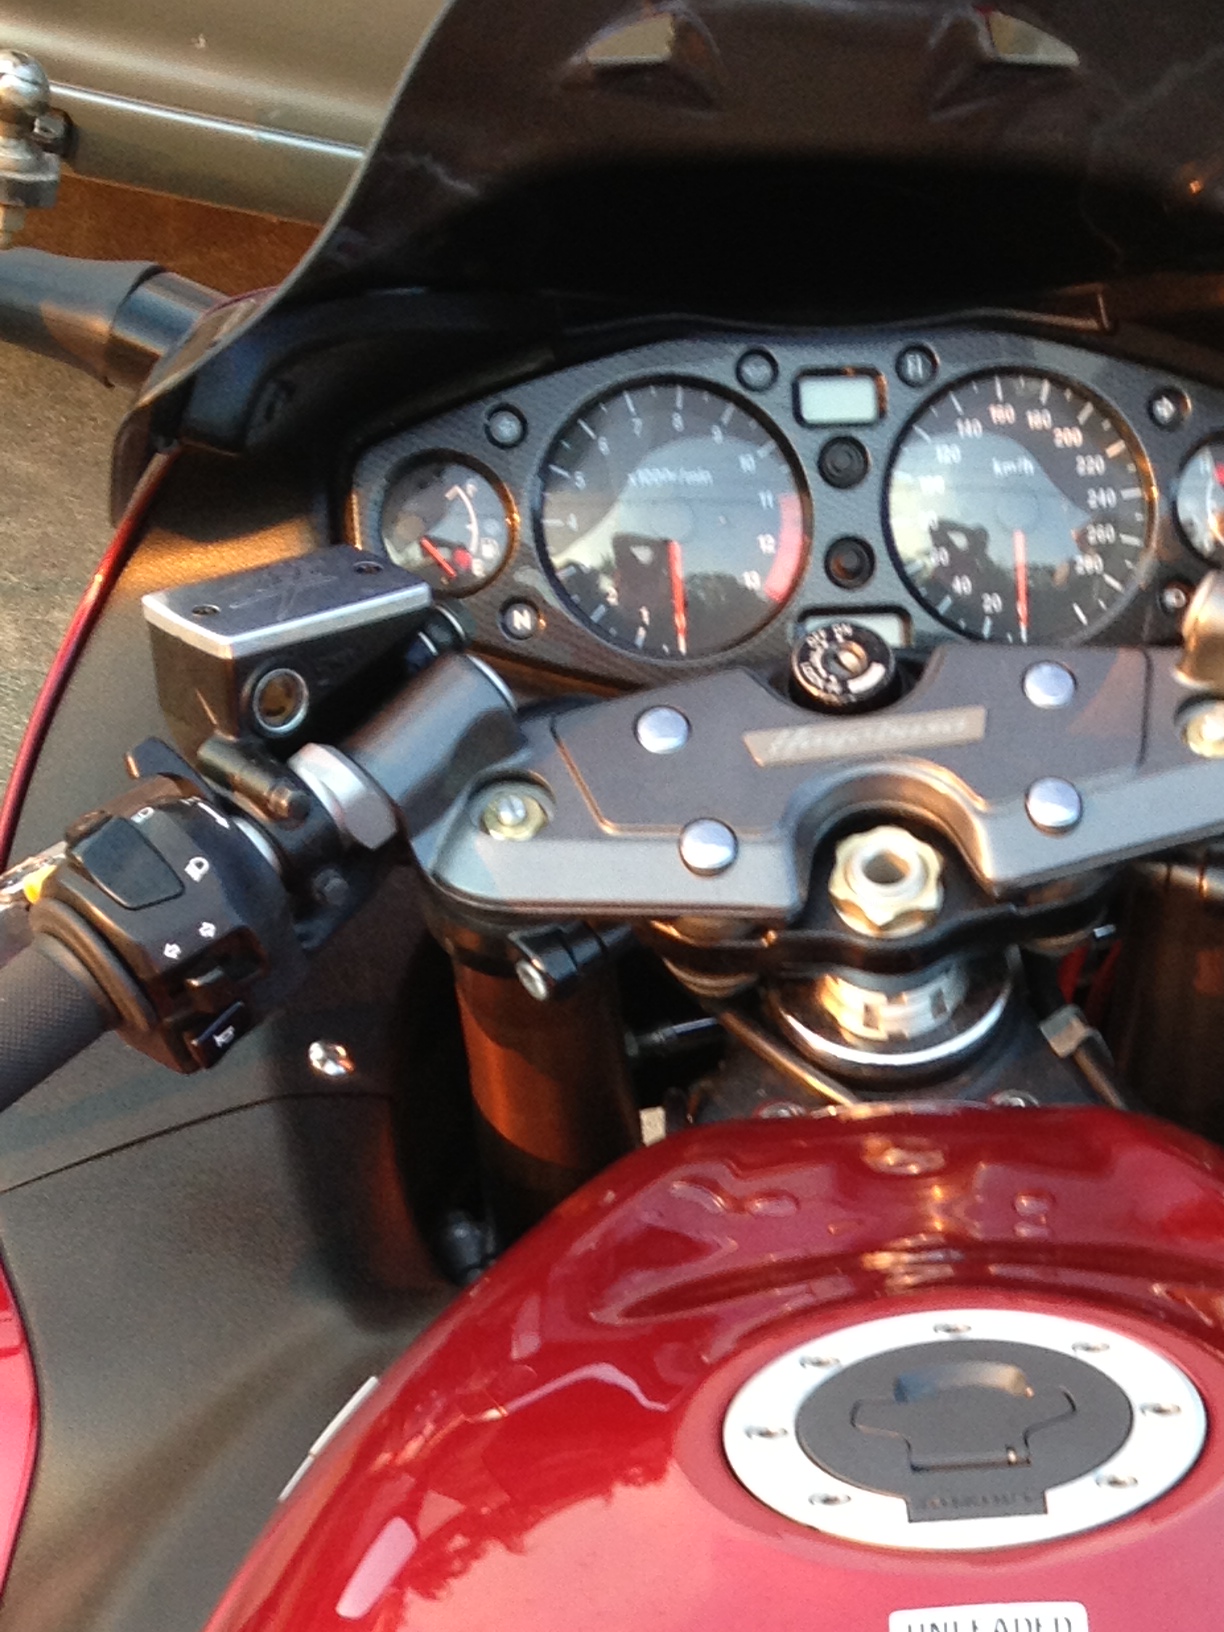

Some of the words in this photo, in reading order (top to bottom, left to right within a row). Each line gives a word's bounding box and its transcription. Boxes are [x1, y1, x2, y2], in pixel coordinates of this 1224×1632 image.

[1053, 427, 1083, 448] 200
[991, 457, 1034, 477] km/h
[758, 489, 774, 510] 11
[757, 533, 776, 555] 12
[952, 574, 973, 596] 40
[981, 592, 1003, 615] 20
[512, 610, 531, 630] N
